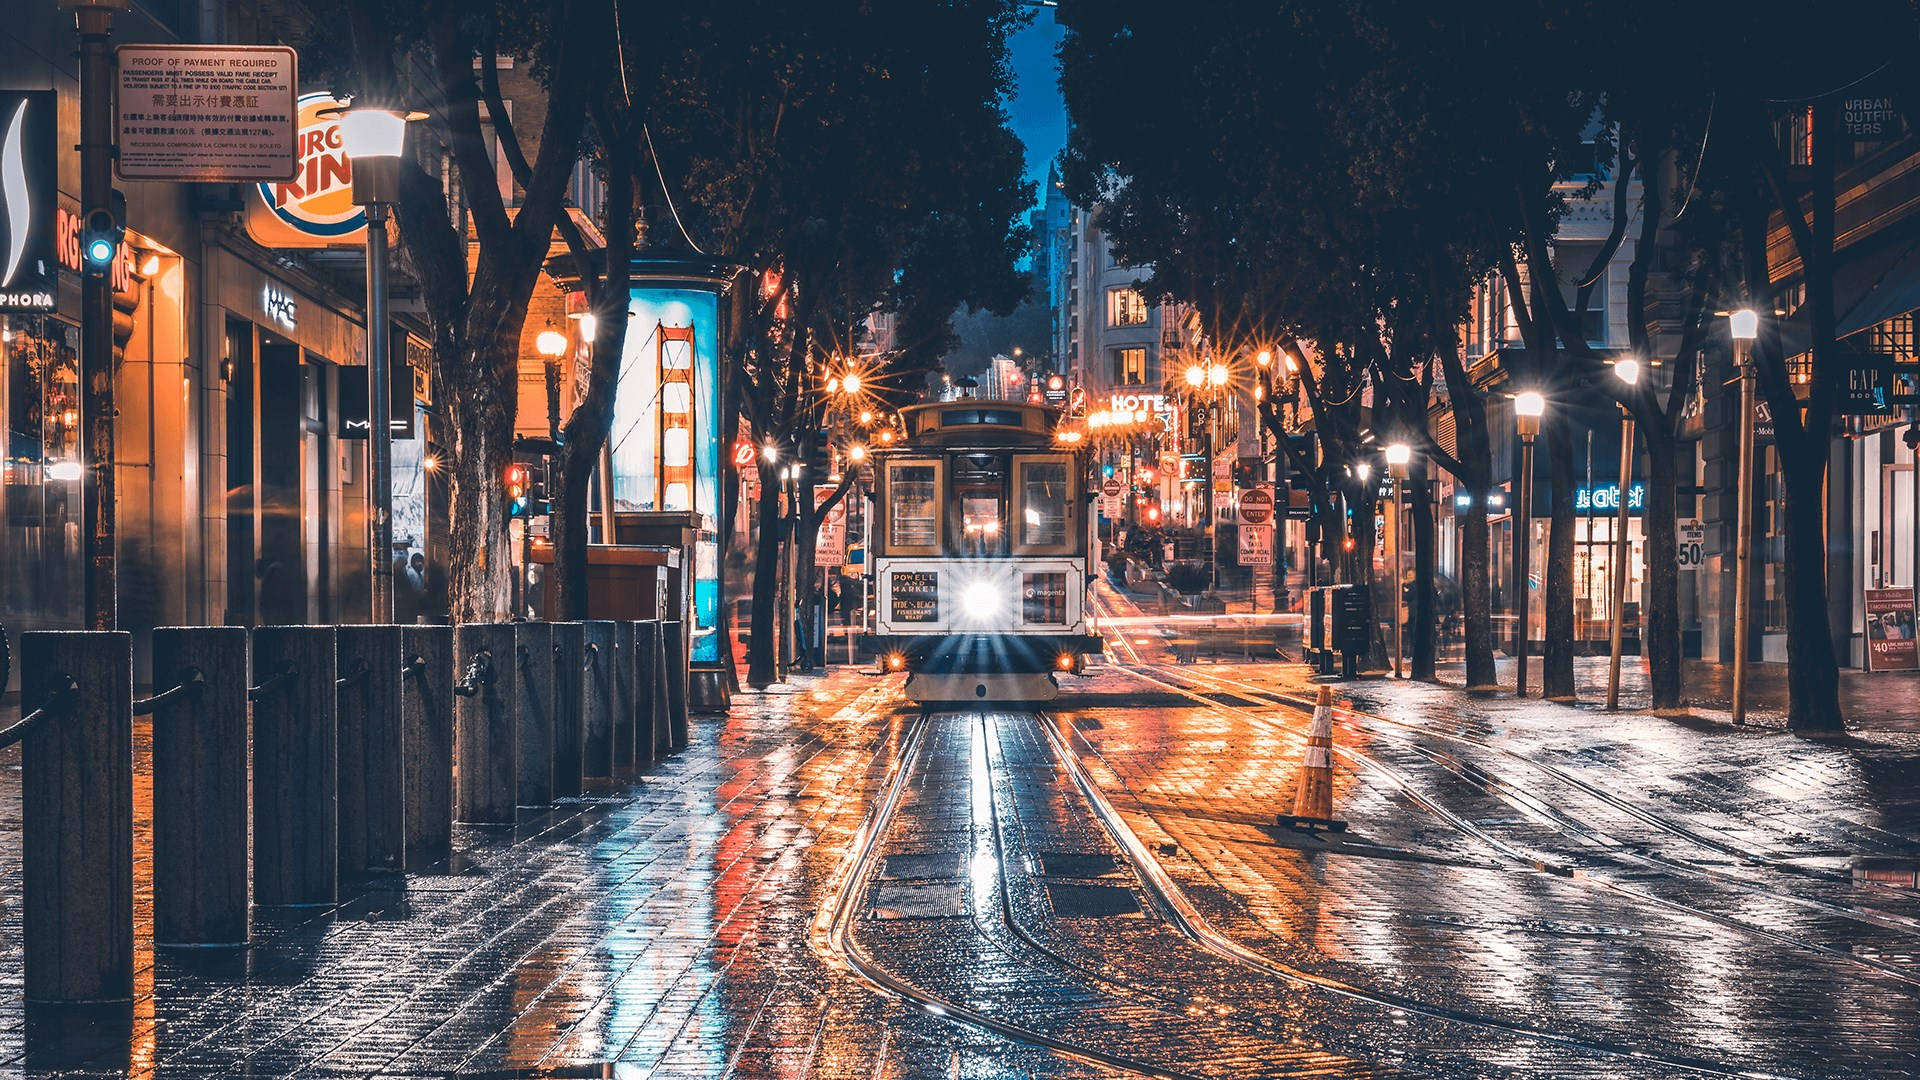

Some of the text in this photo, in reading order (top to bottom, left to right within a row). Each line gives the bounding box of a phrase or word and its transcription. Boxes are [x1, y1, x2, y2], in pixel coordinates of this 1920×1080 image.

[132, 57, 278, 67] PROOF OF PAYMENT REQUIRED
[1845, 98, 1892, 110] URBAN
[1846, 123, 1882, 135] TERS
[1849, 369, 1878, 390] GAP
[346, 420, 408, 429] MC
[1036, 589, 1065, 597] magenta
[916, 600, 936, 609] BEACH
